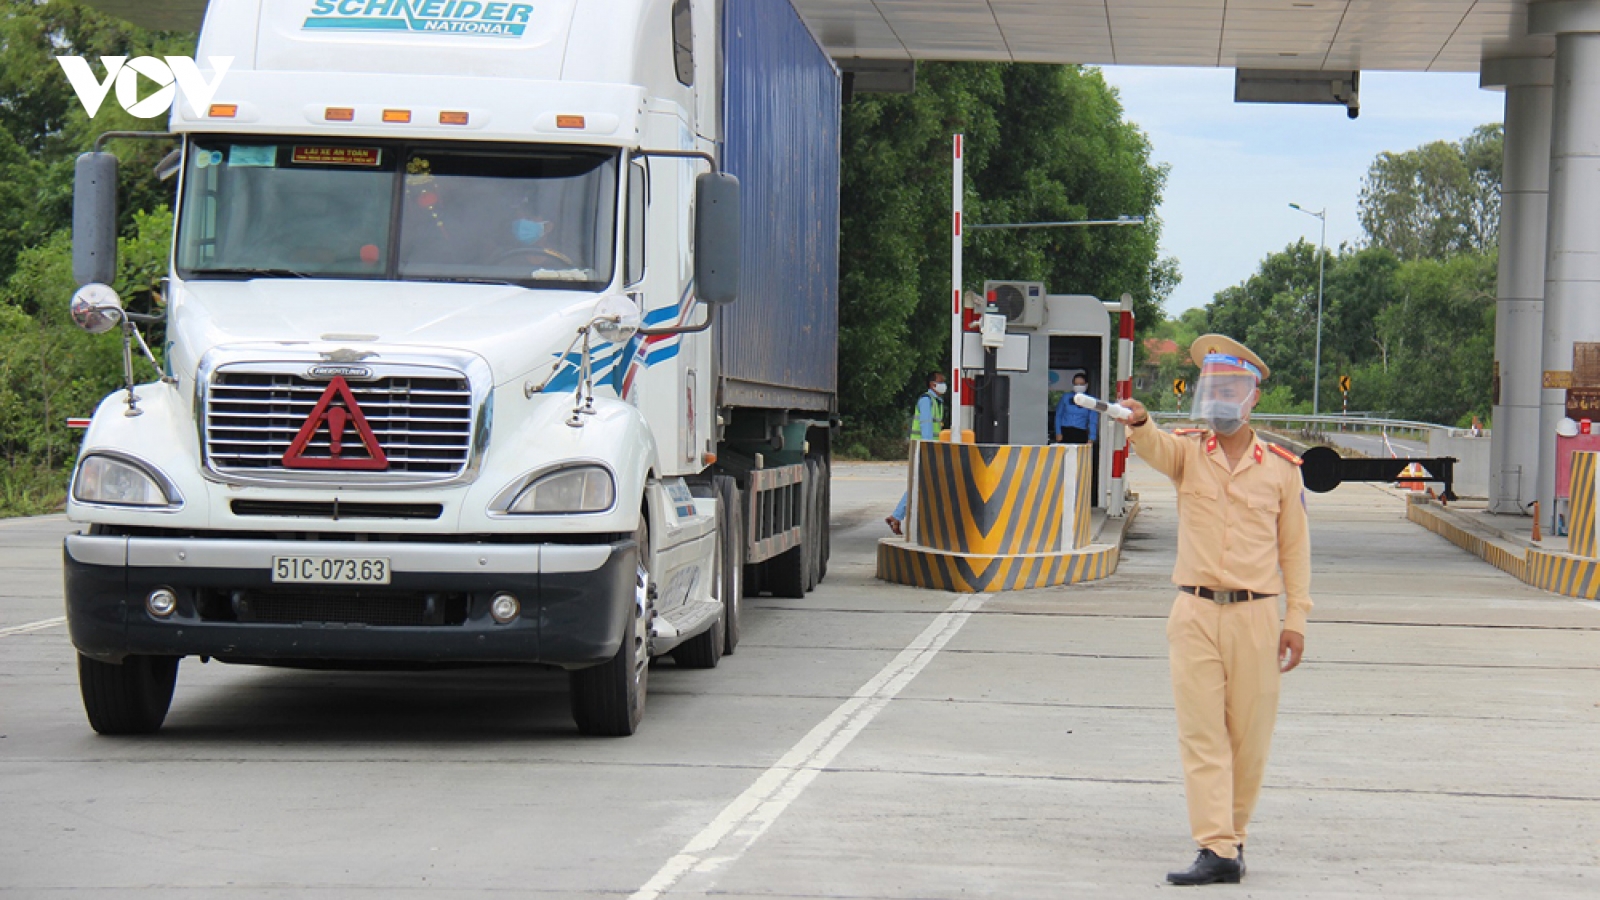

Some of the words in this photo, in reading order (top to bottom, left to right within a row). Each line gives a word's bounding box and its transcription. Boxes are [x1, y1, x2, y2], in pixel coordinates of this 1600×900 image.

[311, 0, 534, 23] SCHNEIDER
[423, 20, 513, 36] NATIONAL
[277, 558, 385, 581] 51C-073.63
